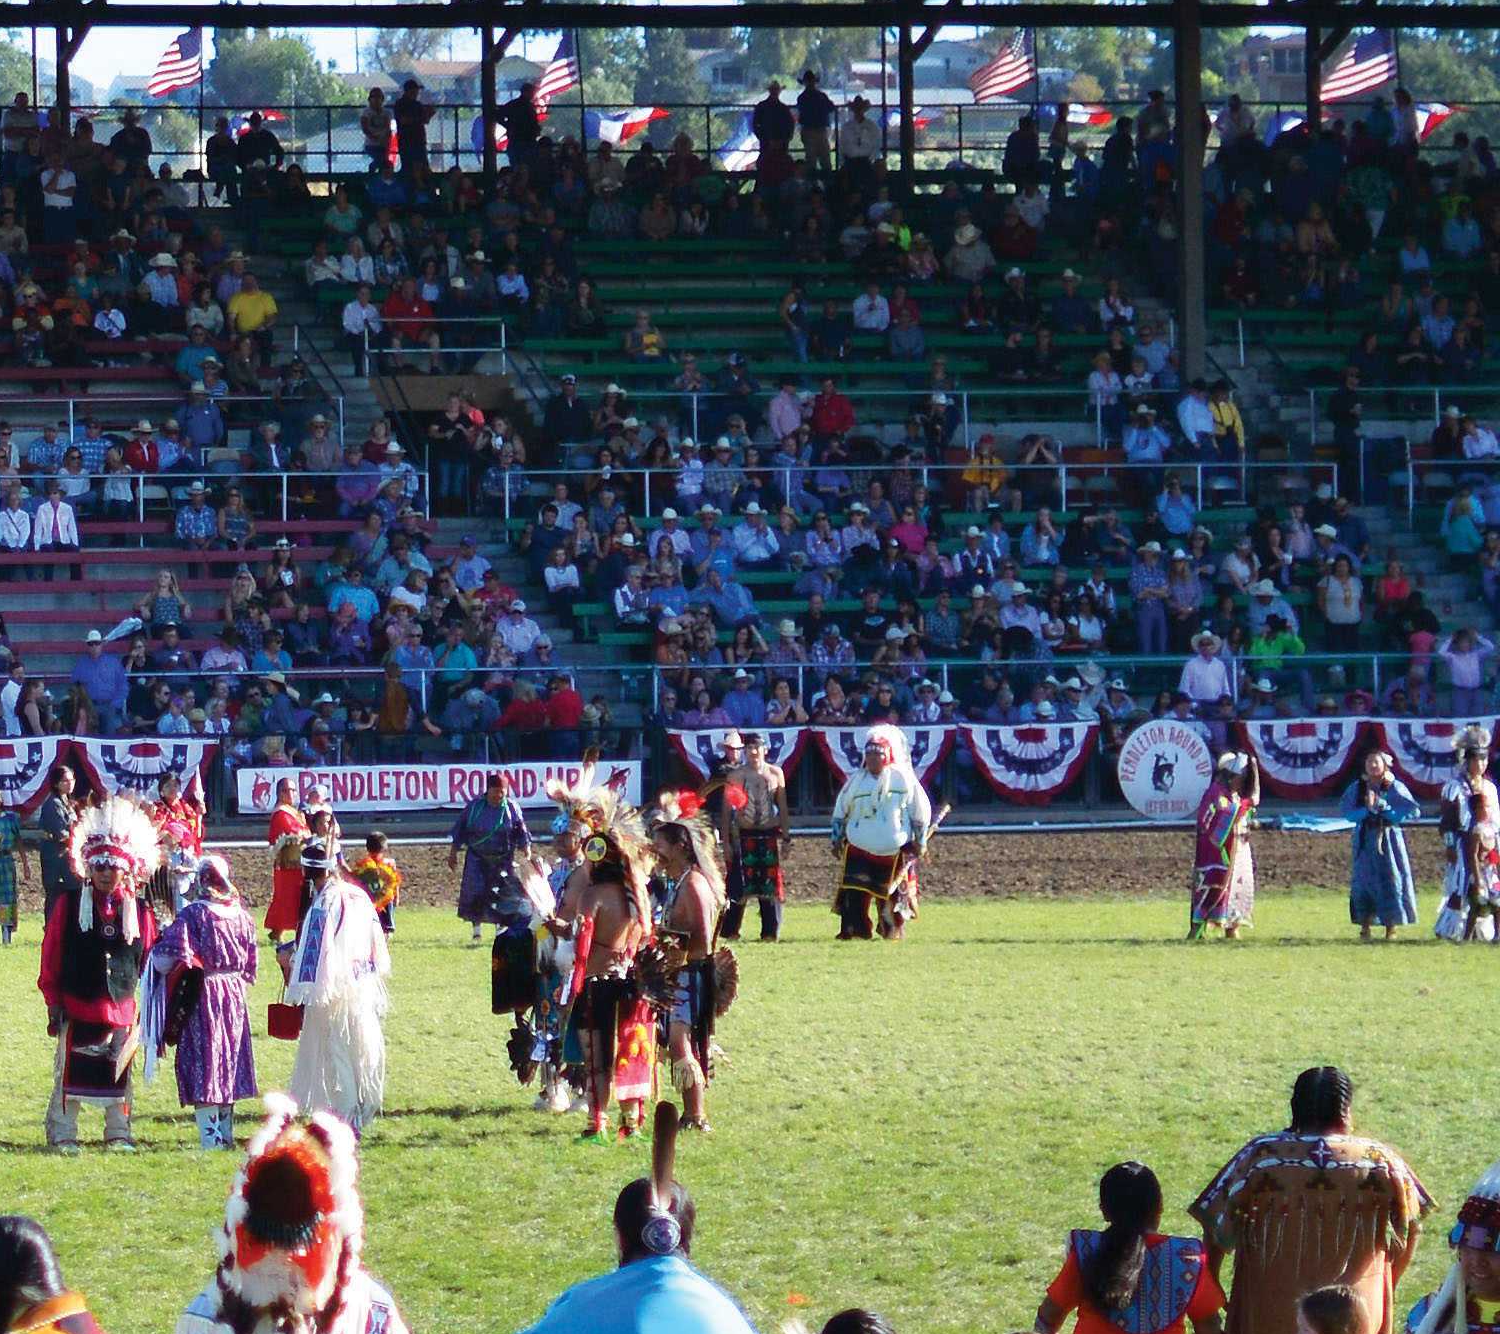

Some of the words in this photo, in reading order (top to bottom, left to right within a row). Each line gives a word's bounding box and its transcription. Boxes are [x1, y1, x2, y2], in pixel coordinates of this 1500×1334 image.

[1120, 726, 1165, 782] PENDLETON
[1168, 726, 1212, 778] ROUND-UP
[298, 770, 438, 809] PENDLETON
